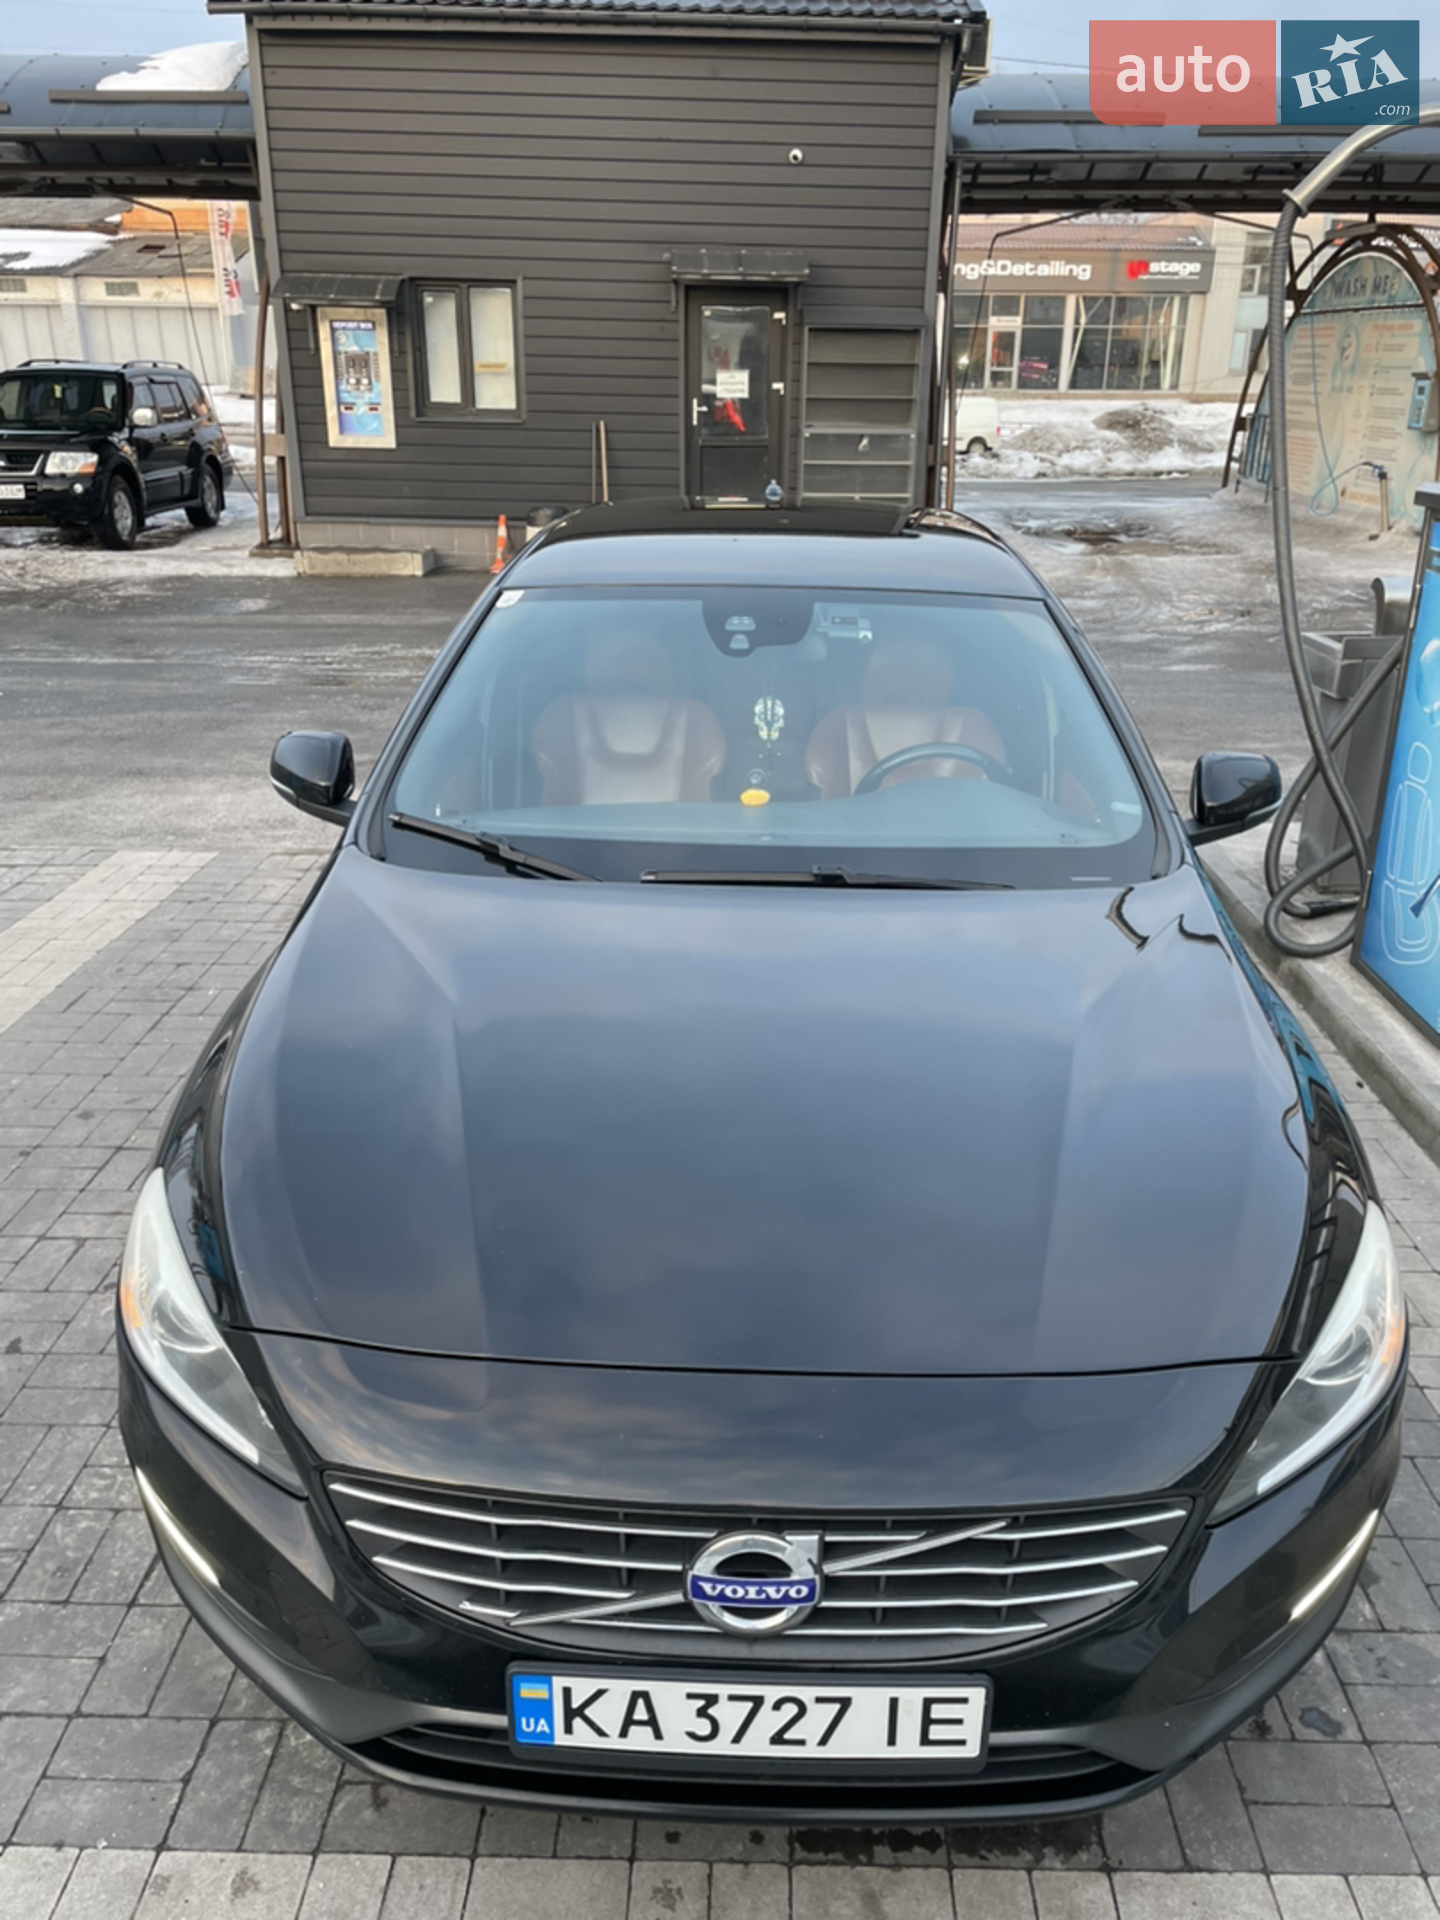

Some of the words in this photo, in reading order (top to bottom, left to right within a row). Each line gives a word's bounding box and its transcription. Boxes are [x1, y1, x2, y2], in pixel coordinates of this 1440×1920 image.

[1333, 275, 1367, 298] WASH
[1371, 273, 1390, 296] ME
[698, 1581, 809, 1600] VOLVO
[521, 1716, 550, 1733] UA
[562, 1686, 663, 1741] KA
[684, 1692, 852, 1747] 3727
[887, 1697, 969, 1747] IE
